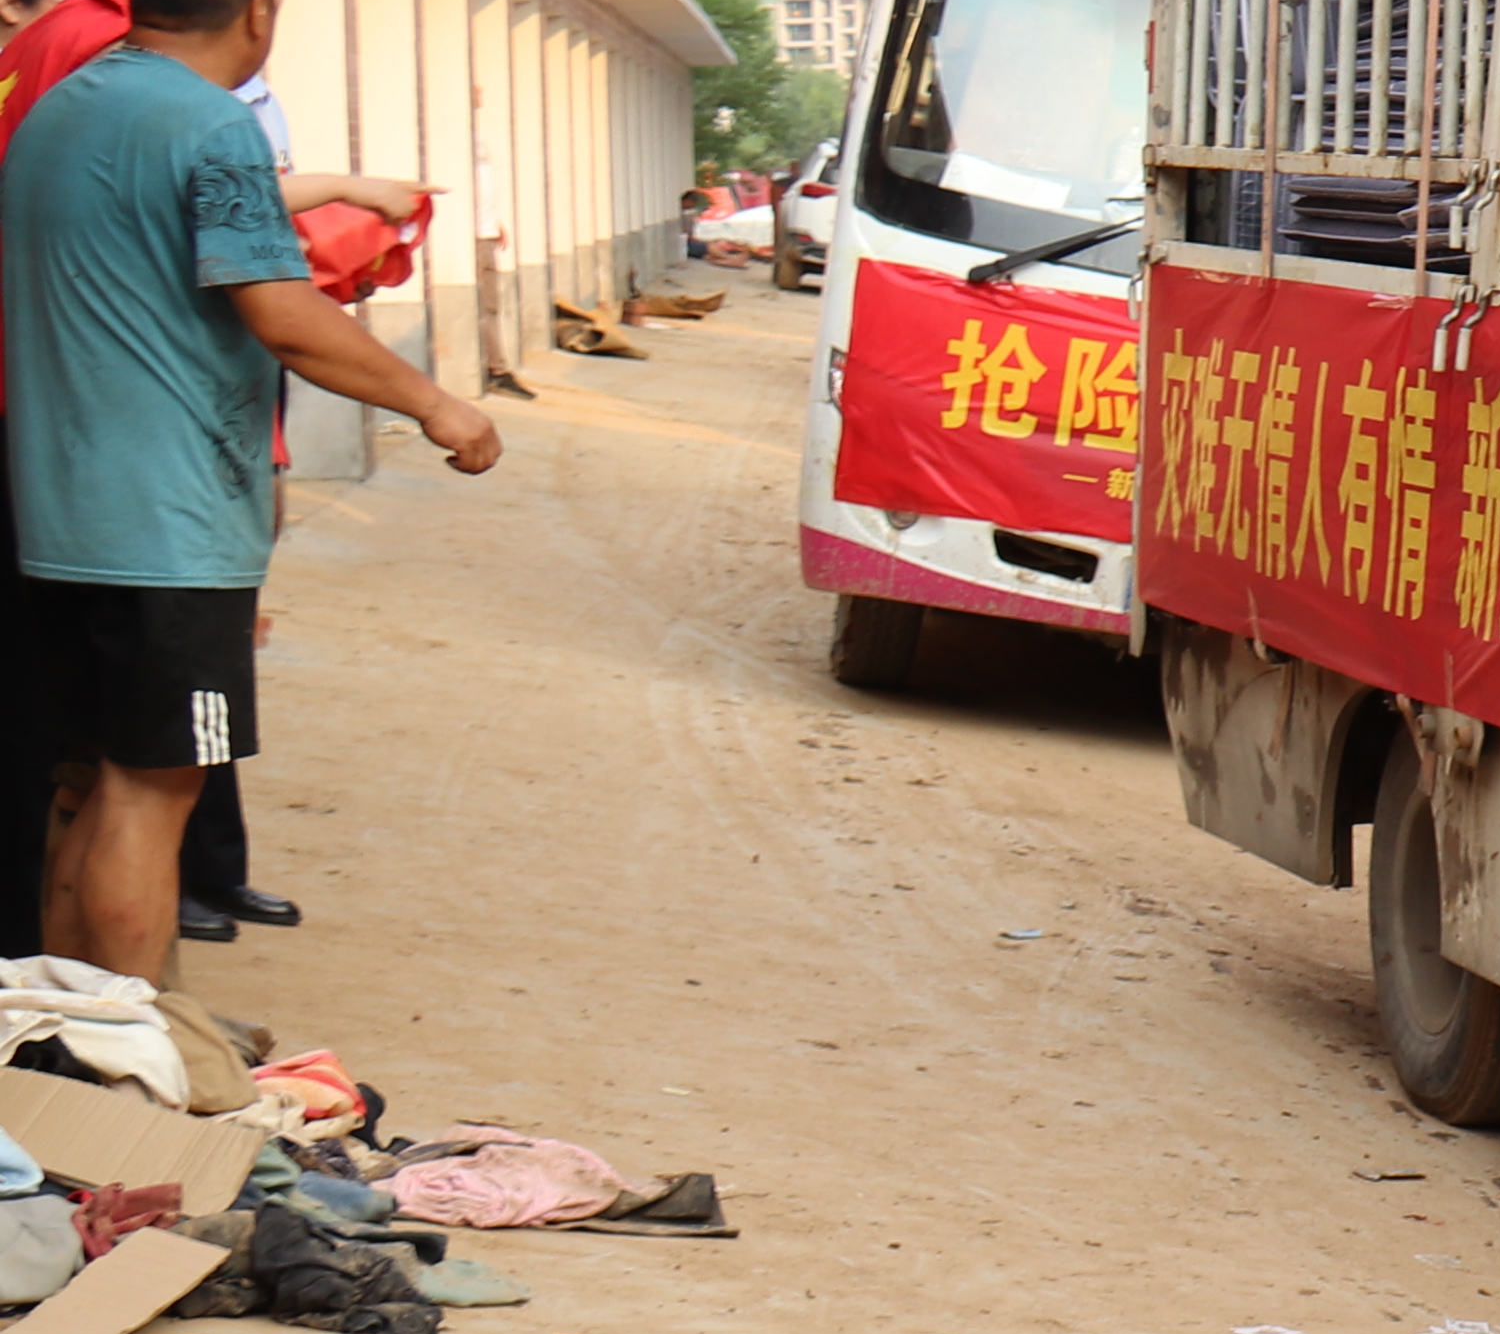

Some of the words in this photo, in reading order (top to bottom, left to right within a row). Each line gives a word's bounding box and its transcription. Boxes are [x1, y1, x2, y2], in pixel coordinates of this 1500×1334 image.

[1153, 327, 1438, 621] 灾难无情人有情
